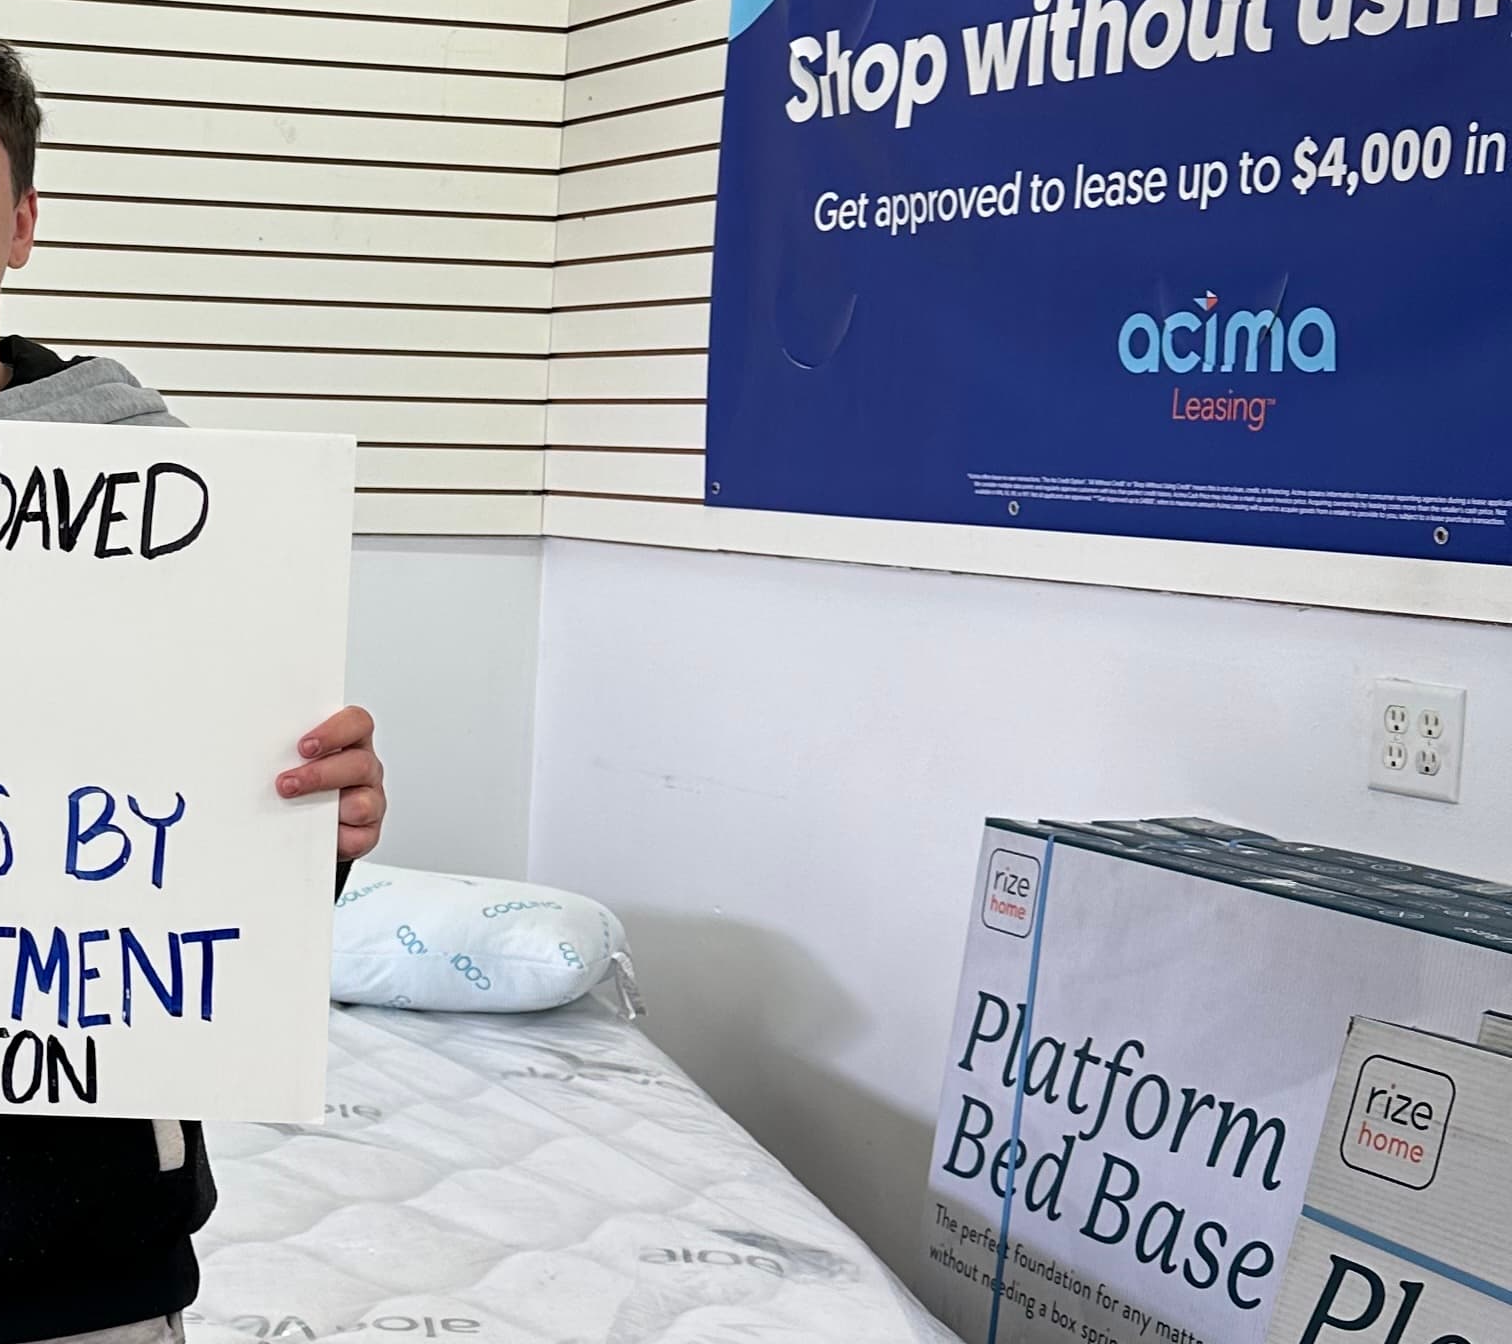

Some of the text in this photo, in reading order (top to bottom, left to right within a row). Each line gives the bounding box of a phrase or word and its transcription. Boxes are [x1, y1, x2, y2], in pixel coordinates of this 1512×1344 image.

[785, 29, 948, 130] Shop
[813, 121, 1506, 236] Get approved to lease up to $4,000 in
[1118, 290, 1337, 374] acima
[65, 786, 187, 888] BY
[993, 866, 1030, 898] rize
[990, 894, 1026, 920] home
[958, 990, 1286, 1191] Platform
[1366, 1083, 1433, 1131] rize
[1357, 1120, 1424, 1163] home
[942, 1094, 1275, 1310] Bed Base
[928, 1243, 979, 1282] without
[1039, 1303, 1047, 1317] a
[1051, 1301, 1076, 1333] box
[935, 1203, 958, 1233] The
[1013, 1243, 1091, 1299] foundation
[1095, 1283, 1120, 1313] for
[1121, 1304, 1153, 1337] any
